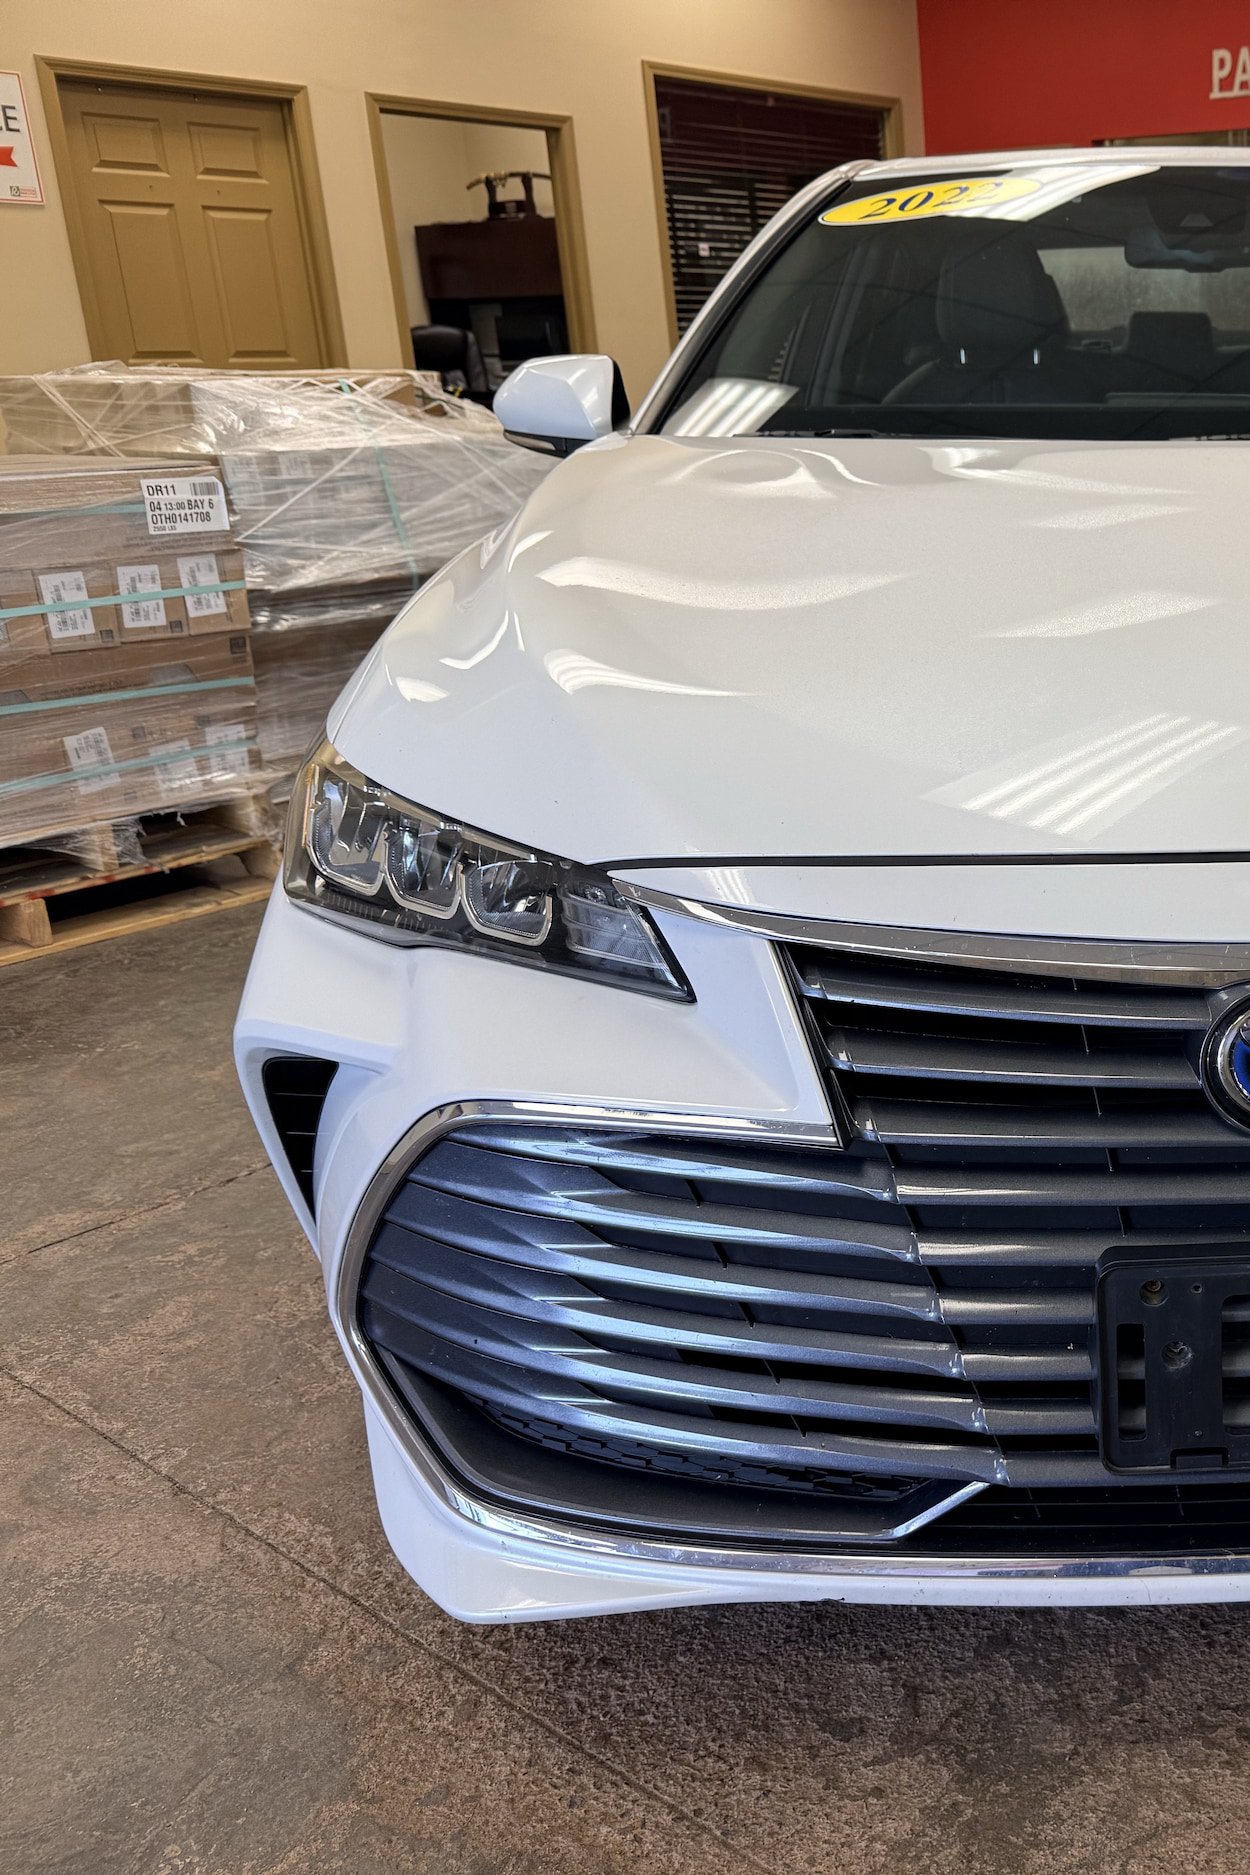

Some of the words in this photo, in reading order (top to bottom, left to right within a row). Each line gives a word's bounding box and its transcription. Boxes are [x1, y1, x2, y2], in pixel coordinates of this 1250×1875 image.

[0, 104, 21, 133] E
[857, 181, 1004, 221] 2022
[146, 484, 176, 497] DR11
[149, 501, 162, 512] 04
[163, 501, 186, 511] 13:00
[187, 499, 205, 510] BAY
[208, 498, 214, 510] 6
